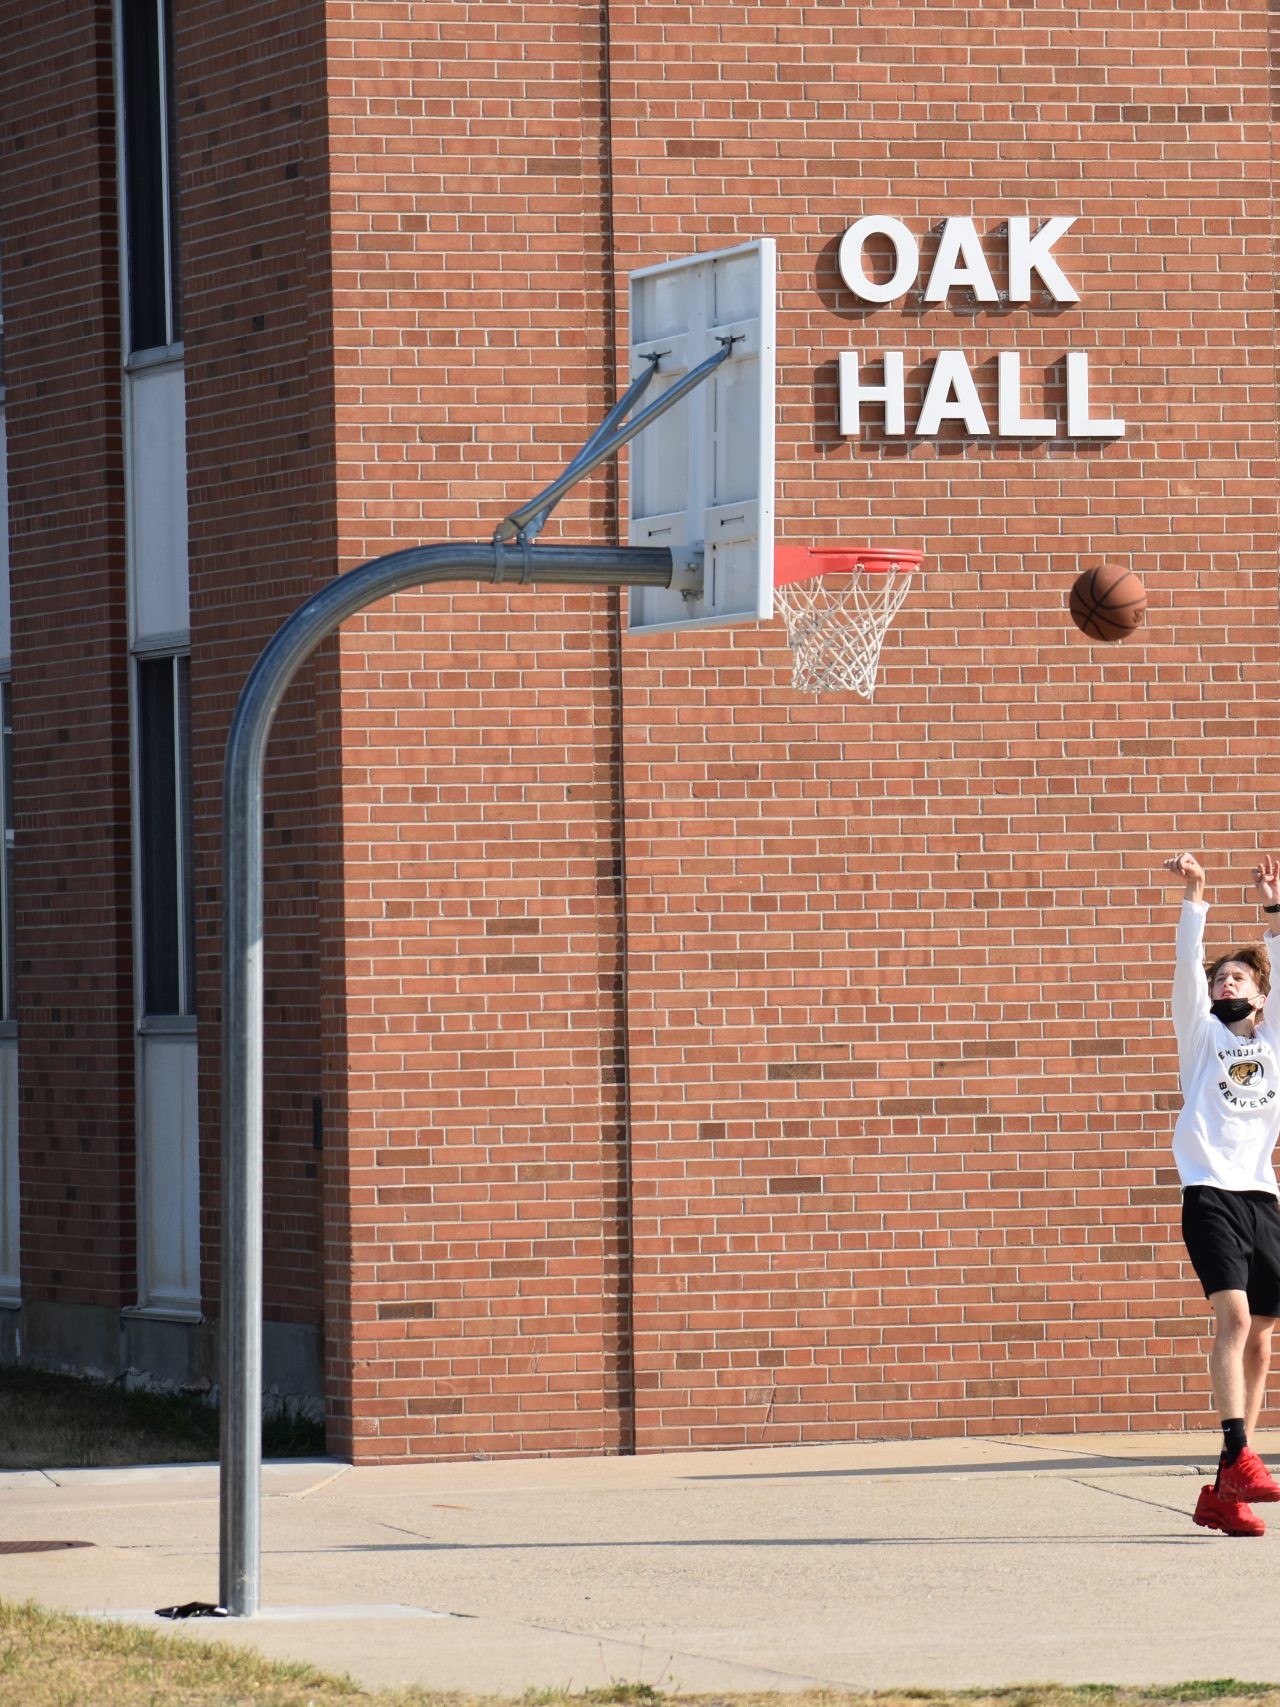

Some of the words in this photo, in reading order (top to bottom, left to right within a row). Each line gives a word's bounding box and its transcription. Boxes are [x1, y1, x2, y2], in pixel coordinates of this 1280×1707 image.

[838, 214, 1081, 303] OAK
[838, 350, 1126, 437] HALL
[1217, 1048, 1254, 1061] EMIDJI
[1218, 1081, 1276, 1109] BEAVERS
